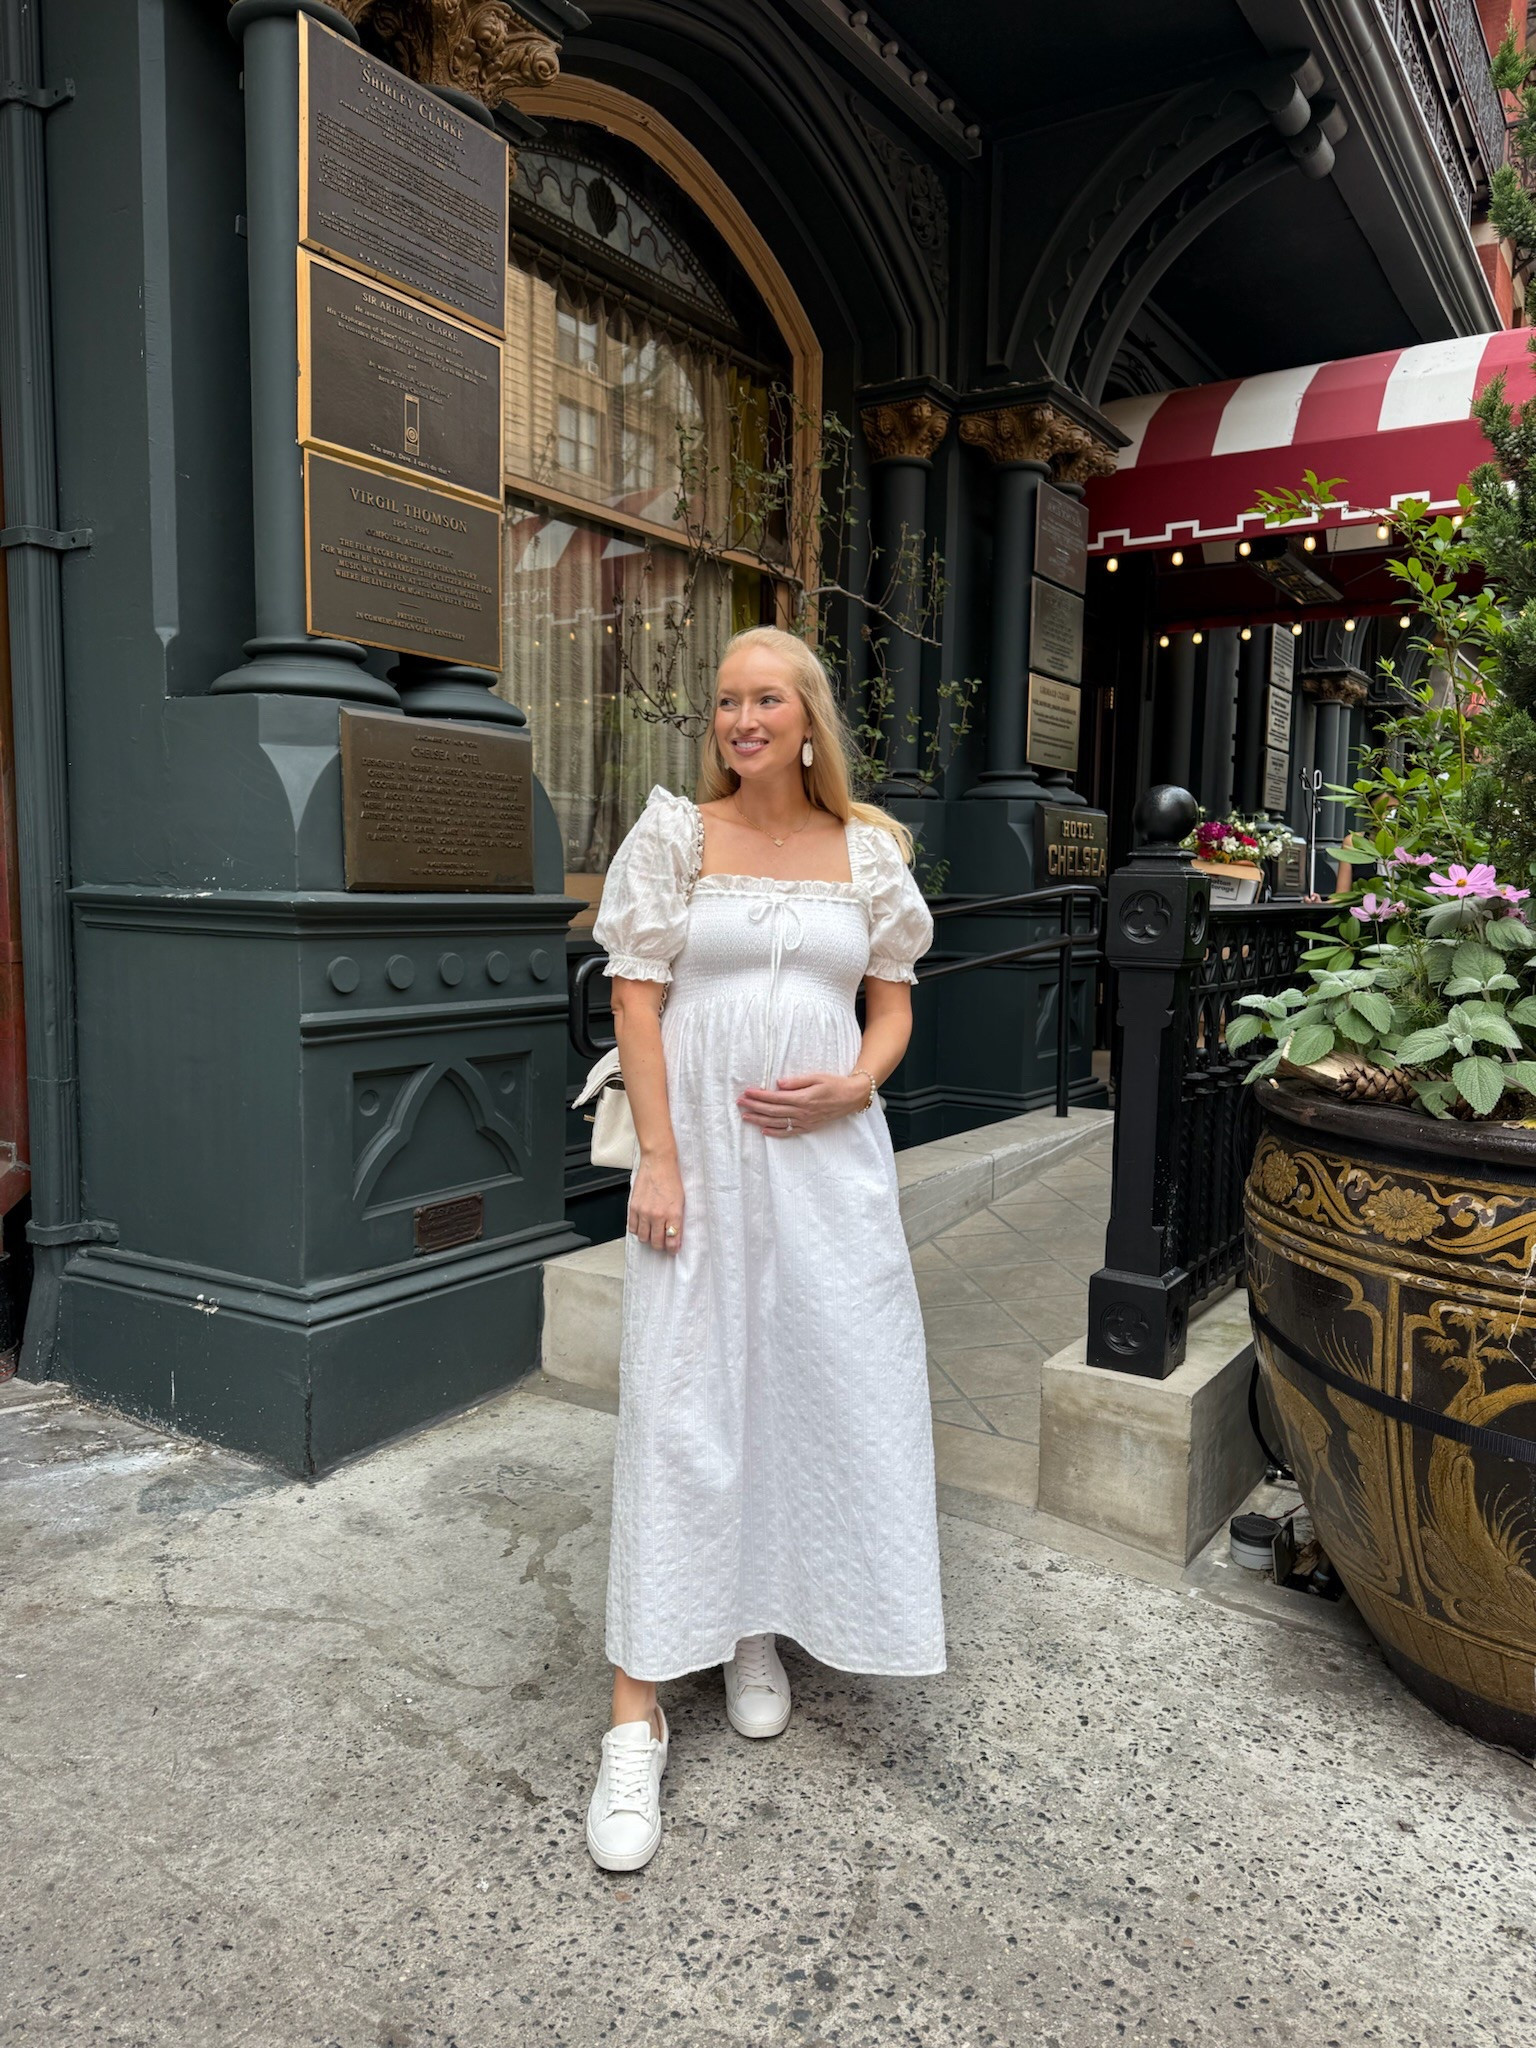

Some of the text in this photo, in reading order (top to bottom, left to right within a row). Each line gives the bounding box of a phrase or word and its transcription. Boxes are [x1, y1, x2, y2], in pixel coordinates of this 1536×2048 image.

[363, 66, 414, 112] SHIRLEY
[418, 101, 464, 142] CLARKE
[363, 291, 377, 306] SIR
[380, 299, 413, 323] ARTHUR
[427, 321, 458, 343] CLARKE
[350, 487, 468, 534] VIRGIL THOMSON
[321, 543, 336, 556] FOR
[337, 548, 360, 562] WHICH
[362, 554, 371, 565] HE
[373, 557, 387, 569] WAS
[339, 537, 354, 549] THE
[355, 541, 372, 554] FILM
[373, 546, 395, 559] SCORE
[396, 552, 409, 563] FOR
[410, 556, 423, 567] THE
[458, 568, 477, 581] STORY
[335, 568, 359, 582] WHERE
[360, 574, 370, 585] HE
[371, 577, 392, 590] LIVED
[393, 582, 407, 593] FOR
[338, 559, 361, 573] MUSIC
[363, 565, 377, 577] WAS
[378, 569, 407, 584] WRITTEN
[408, 577, 417, 586] AT
[411, 746, 482, 765] CHELSEA HOTEL
[1063, 820, 1094, 840] HOTEL
[1048, 844, 1107, 877] CHELSEA
